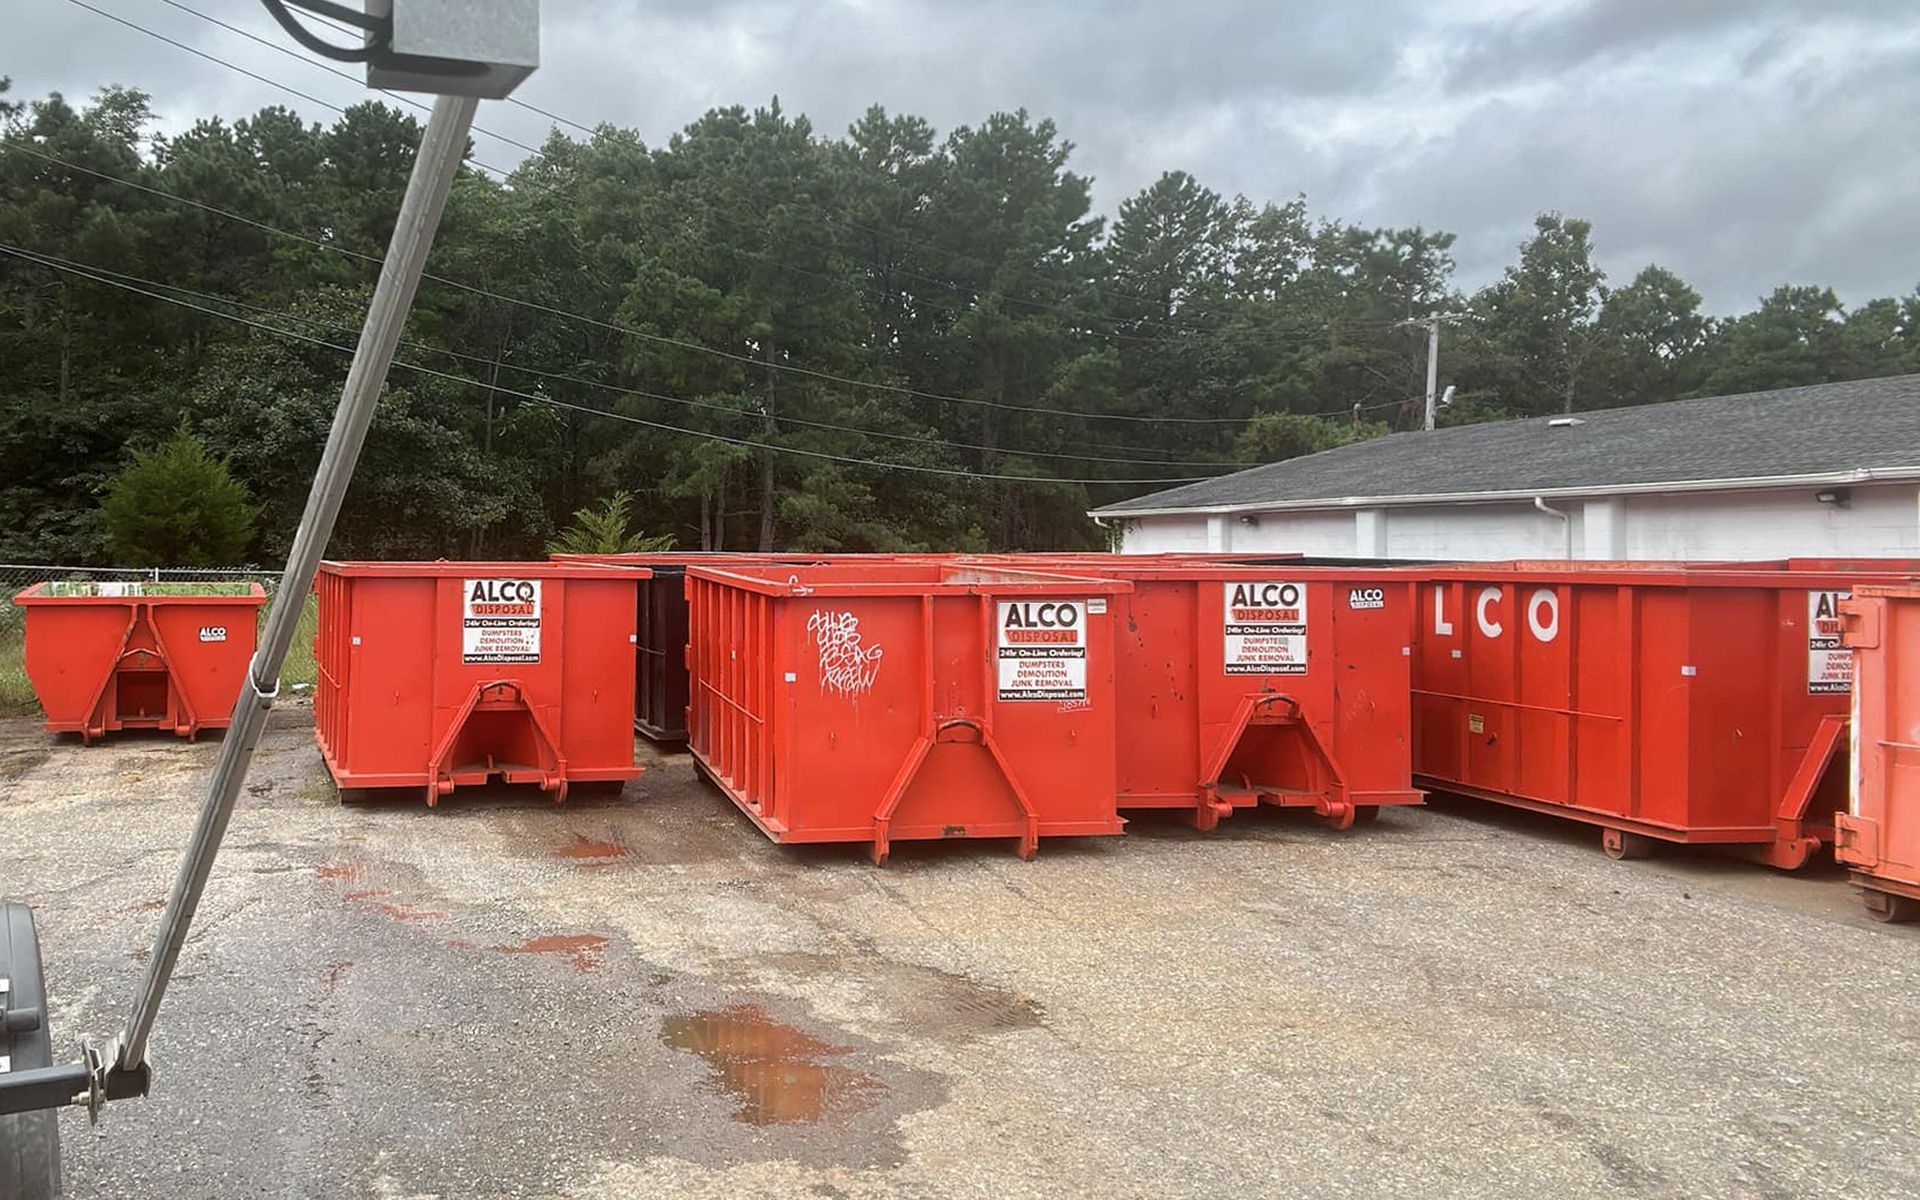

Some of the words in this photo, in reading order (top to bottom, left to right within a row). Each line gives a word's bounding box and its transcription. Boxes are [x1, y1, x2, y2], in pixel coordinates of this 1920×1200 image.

[470, 581, 535, 602] ALCO
[1231, 584, 1299, 607] ALCO
[1350, 589, 1383, 601] ALCO
[475, 604, 533, 615] DISPOSAL
[1816, 593, 1852, 618] AL
[1005, 603, 1078, 628] ALCO
[1236, 609, 1297, 620] DISPOSAL
[200, 627, 226, 636] ALCO
[1012, 631, 1076, 643] DISPOSAL
[480, 637, 524, 645] DEMOLITION
[1244, 637, 1288, 645] DUMPSTE
[1000, 649, 1017, 657] 24hr
[1017, 670, 1067, 678] DEMOLITION
[1001, 691, 1084, 699] www.AlcoDisposal.com
